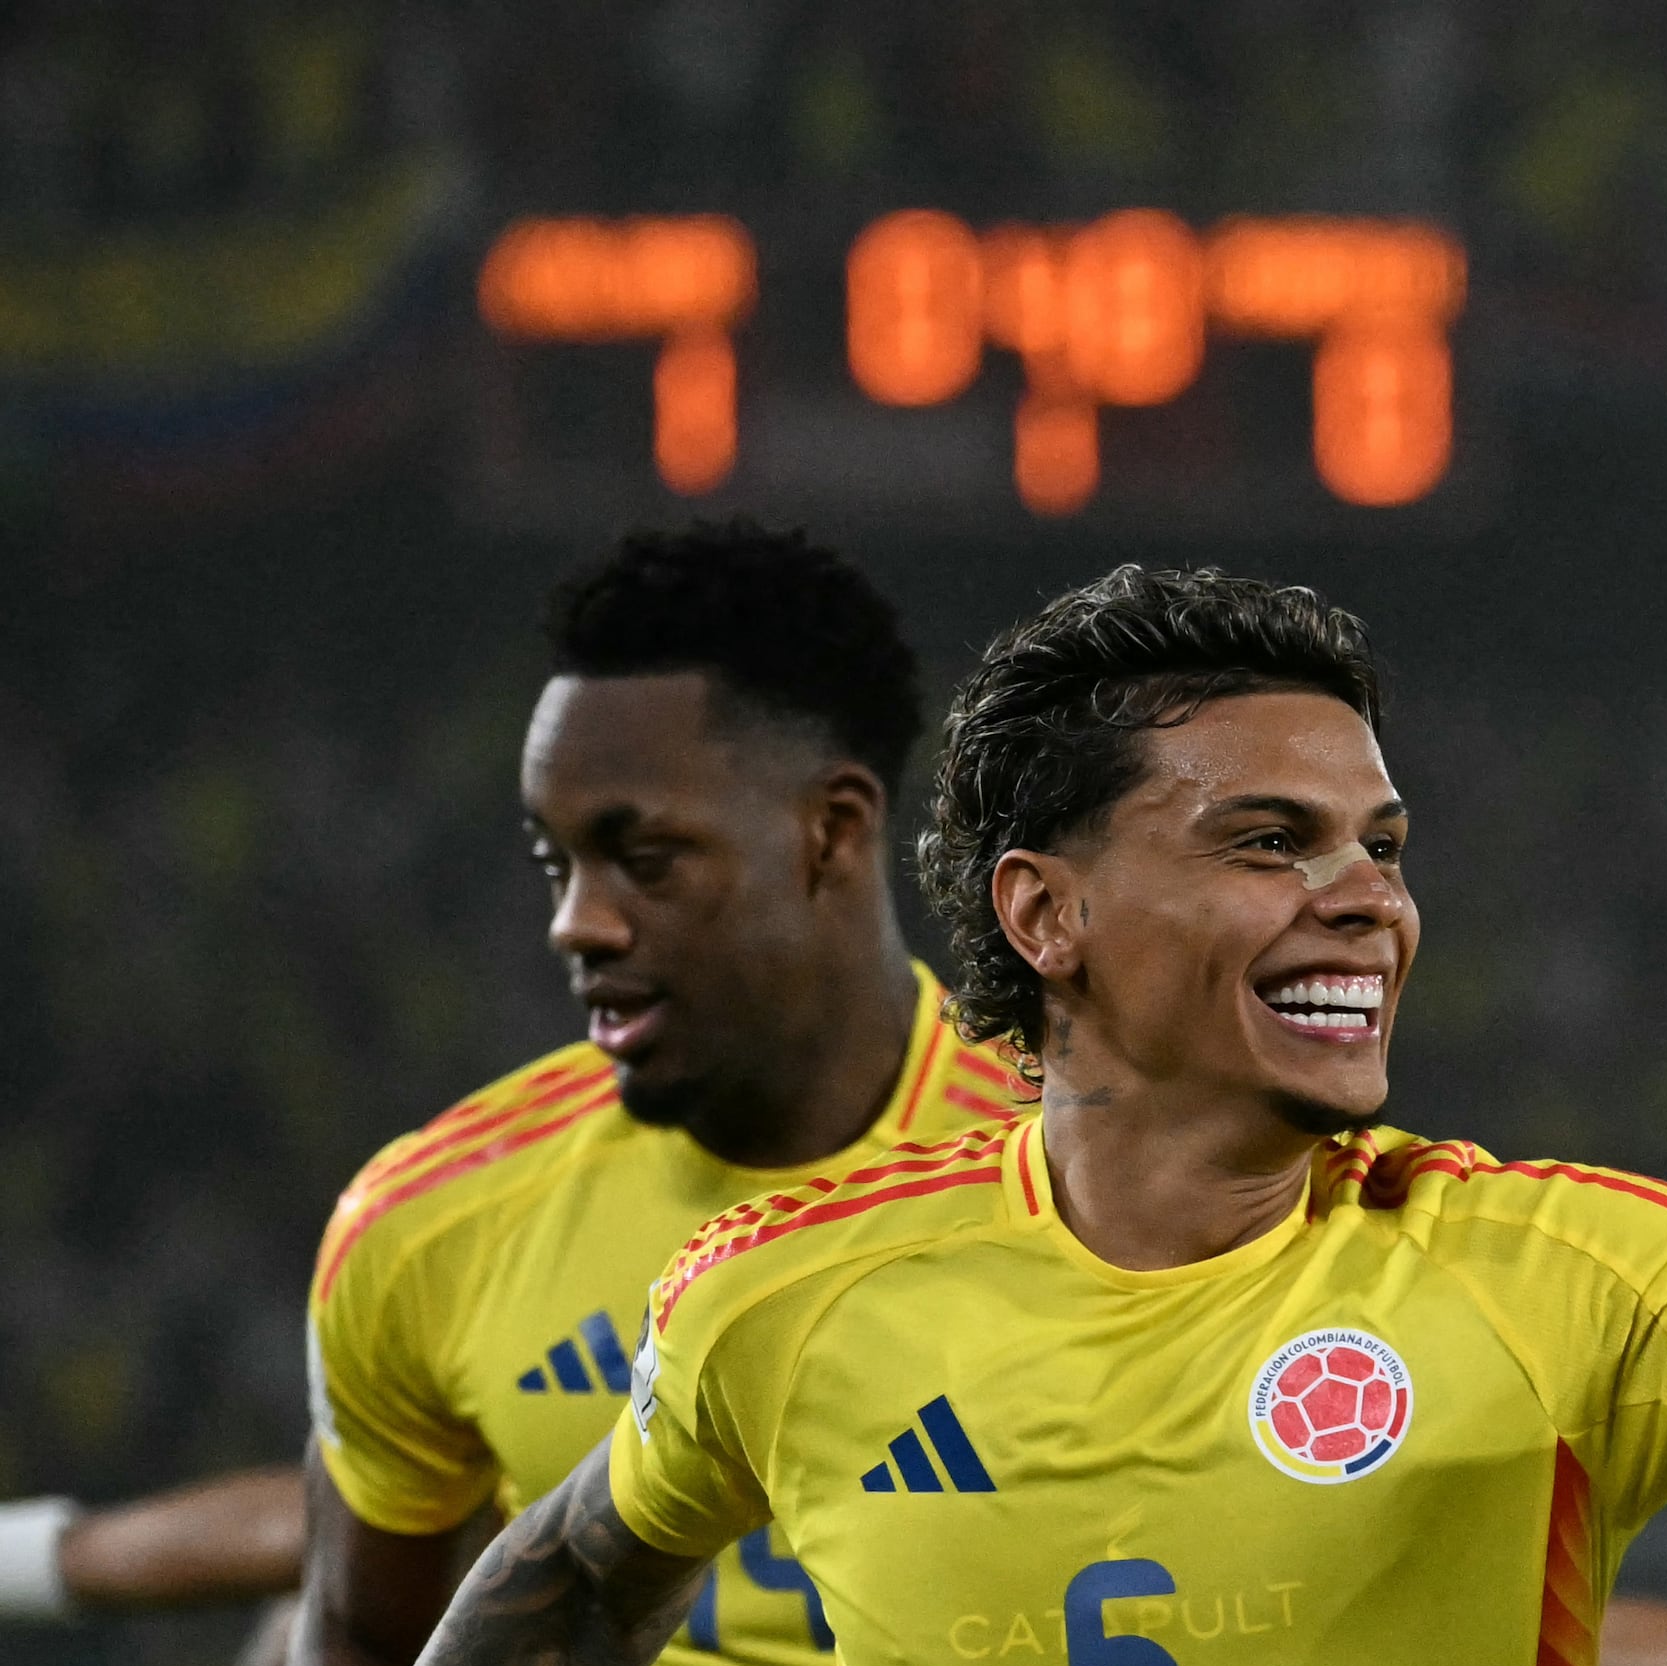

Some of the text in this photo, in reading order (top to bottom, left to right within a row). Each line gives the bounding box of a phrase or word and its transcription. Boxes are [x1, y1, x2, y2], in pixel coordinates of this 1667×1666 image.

[1288, 1333, 1362, 1357] COLOMBIANA
[1364, 1340, 1379, 1354] DE
[948, 1580, 1305, 1660] CATPULT
